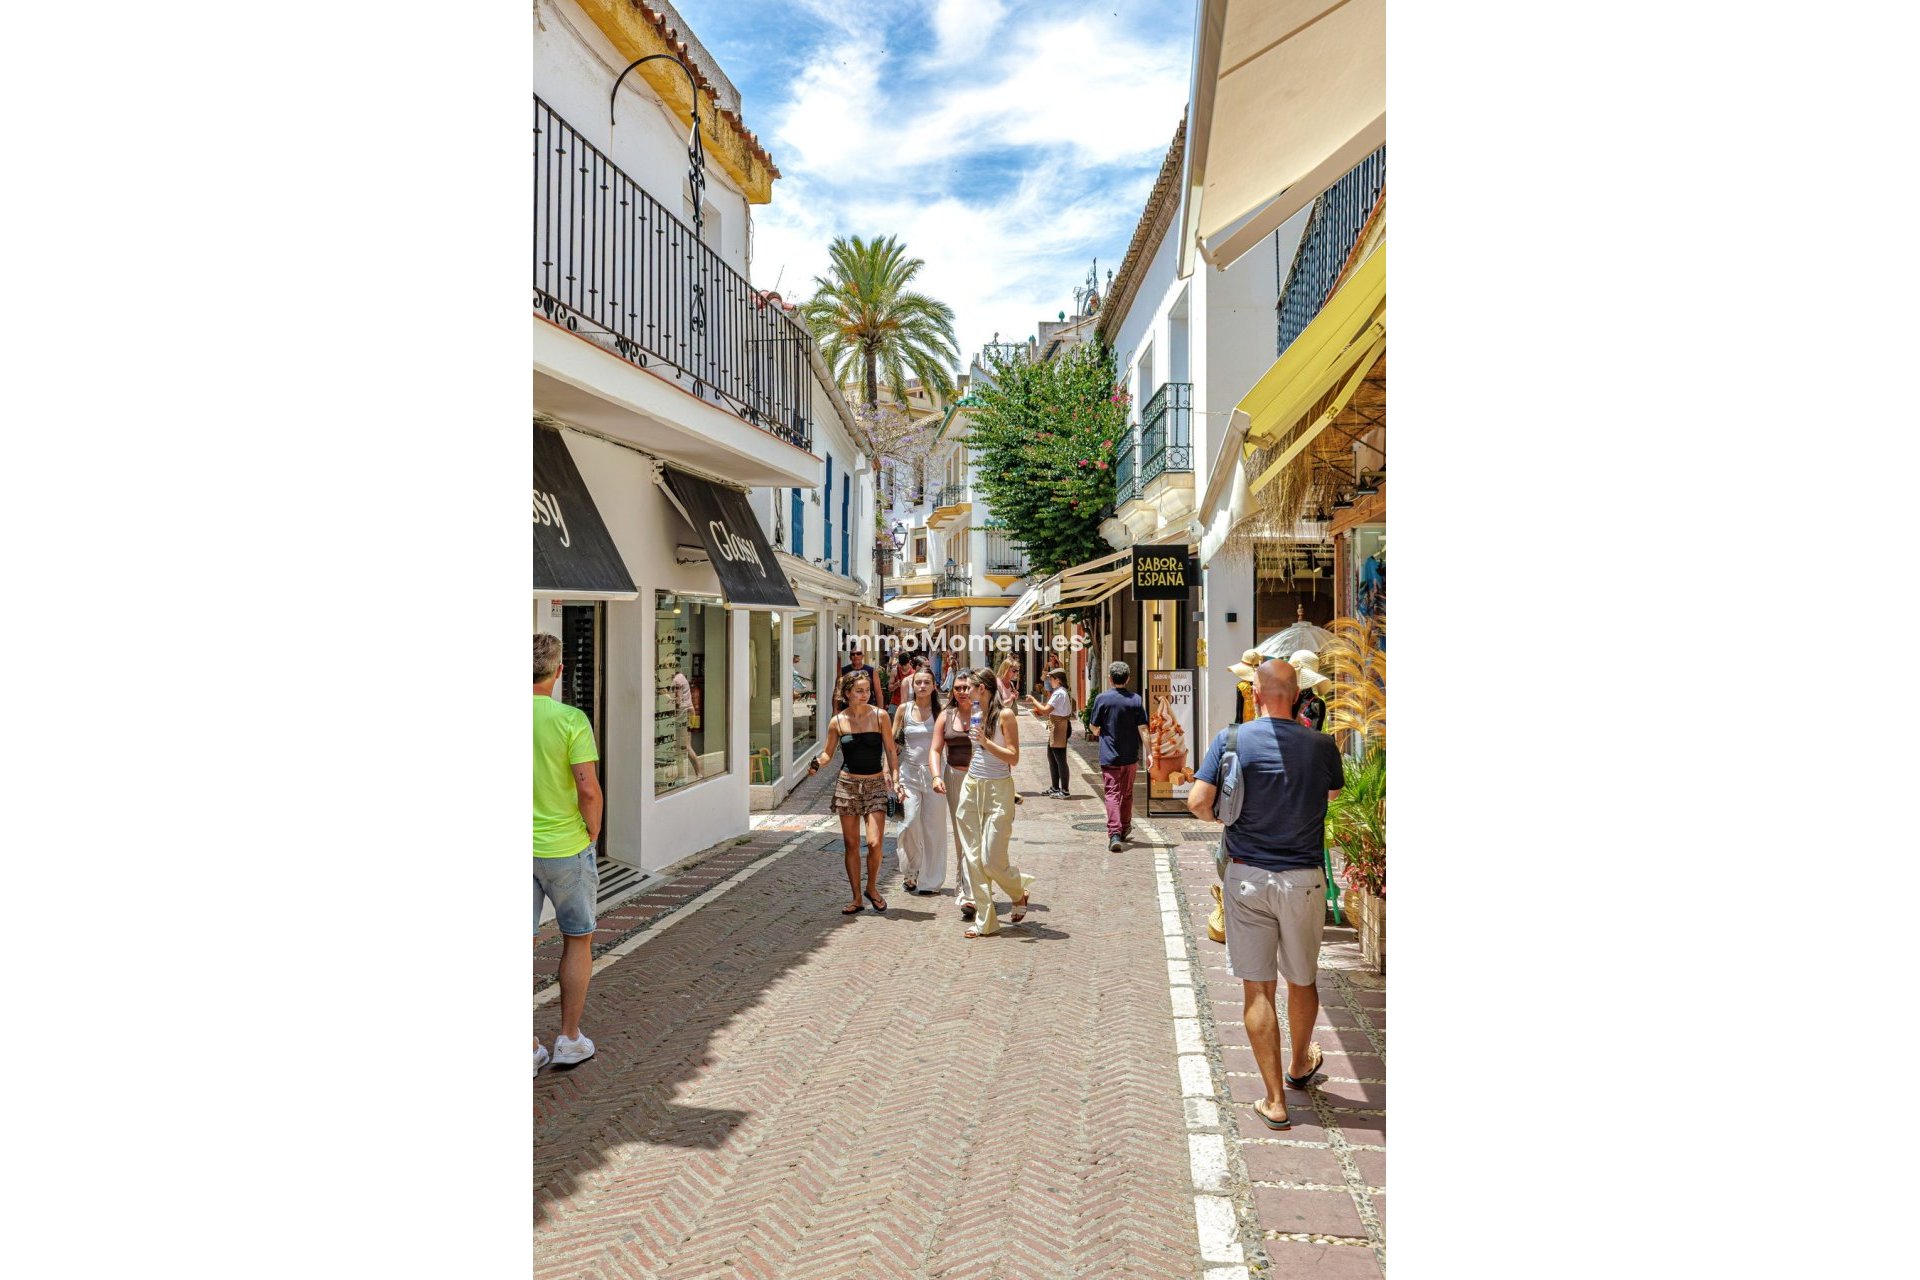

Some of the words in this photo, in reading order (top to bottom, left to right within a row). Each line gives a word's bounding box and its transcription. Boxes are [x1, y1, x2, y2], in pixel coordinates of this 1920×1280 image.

[709, 520, 767, 578] Glossy
[1137, 557, 1177, 572] SABOR
[1137, 571, 1185, 587] ESPAÑA
[1151, 684, 1191, 693] HELADO
